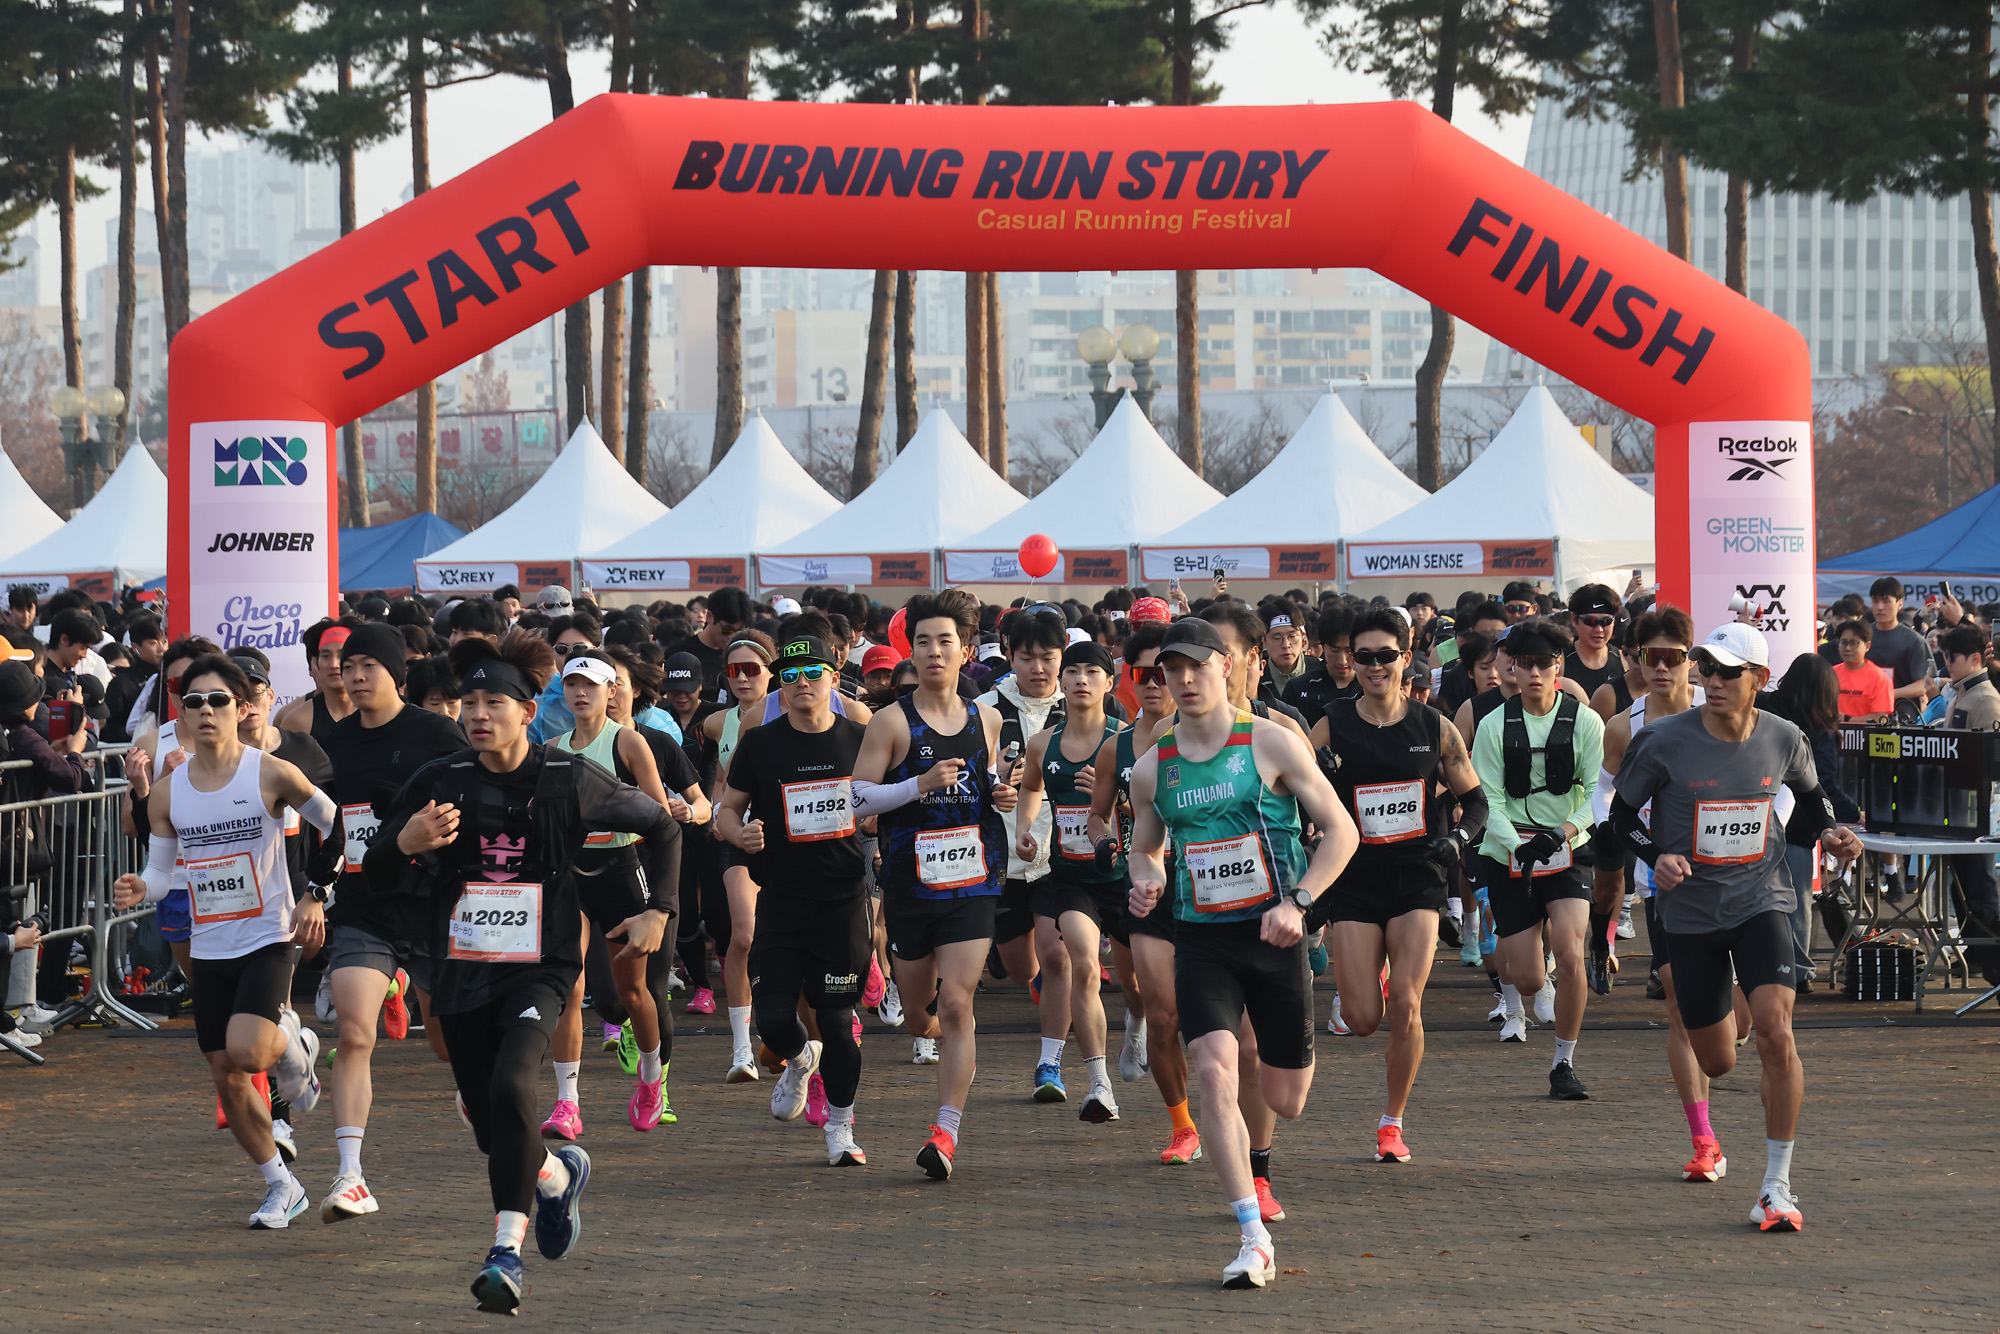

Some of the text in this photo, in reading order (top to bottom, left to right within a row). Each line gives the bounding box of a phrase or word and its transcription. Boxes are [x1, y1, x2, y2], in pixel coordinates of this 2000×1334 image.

[672, 140, 1331, 200] BURNING RUN STORY
[977, 208, 1291, 234] Casual Running Festival
[317, 180, 591, 381] START
[1446, 196, 1716, 386] FINISH
[1012, 357, 1025, 392] 12
[810, 366, 850, 401] 13
[1718, 437, 1797, 456] Reebok
[1707, 517, 1772, 534] GREEN
[208, 532, 314, 553] JOHNBER
[1723, 536, 1805, 553] MONSTER
[993, 555, 1018, 567] Choco
[1173, 554, 1240, 572] 온누리 Store
[1365, 553, 1464, 570] WOMAN SENSE
[461, 571, 495, 583] REXY
[629, 569, 666, 581] REXY
[991, 566, 1019, 578] Health
[224, 596, 302, 622] Choco
[217, 619, 305, 650] Health
[786, 643, 806, 655] TYR
[669, 669, 691, 679] HOKA
[1875, 737, 1894, 753] 5km
[1902, 735, 1959, 759] SAMIK
[920, 795, 979, 804] RUNNING TEAM
[1177, 782, 1235, 808] LITHUANIA
[210, 815, 262, 832] UNIVERSITY
[1224, 842, 1244, 850] STORY
[825, 973, 859, 984] CrossFit
